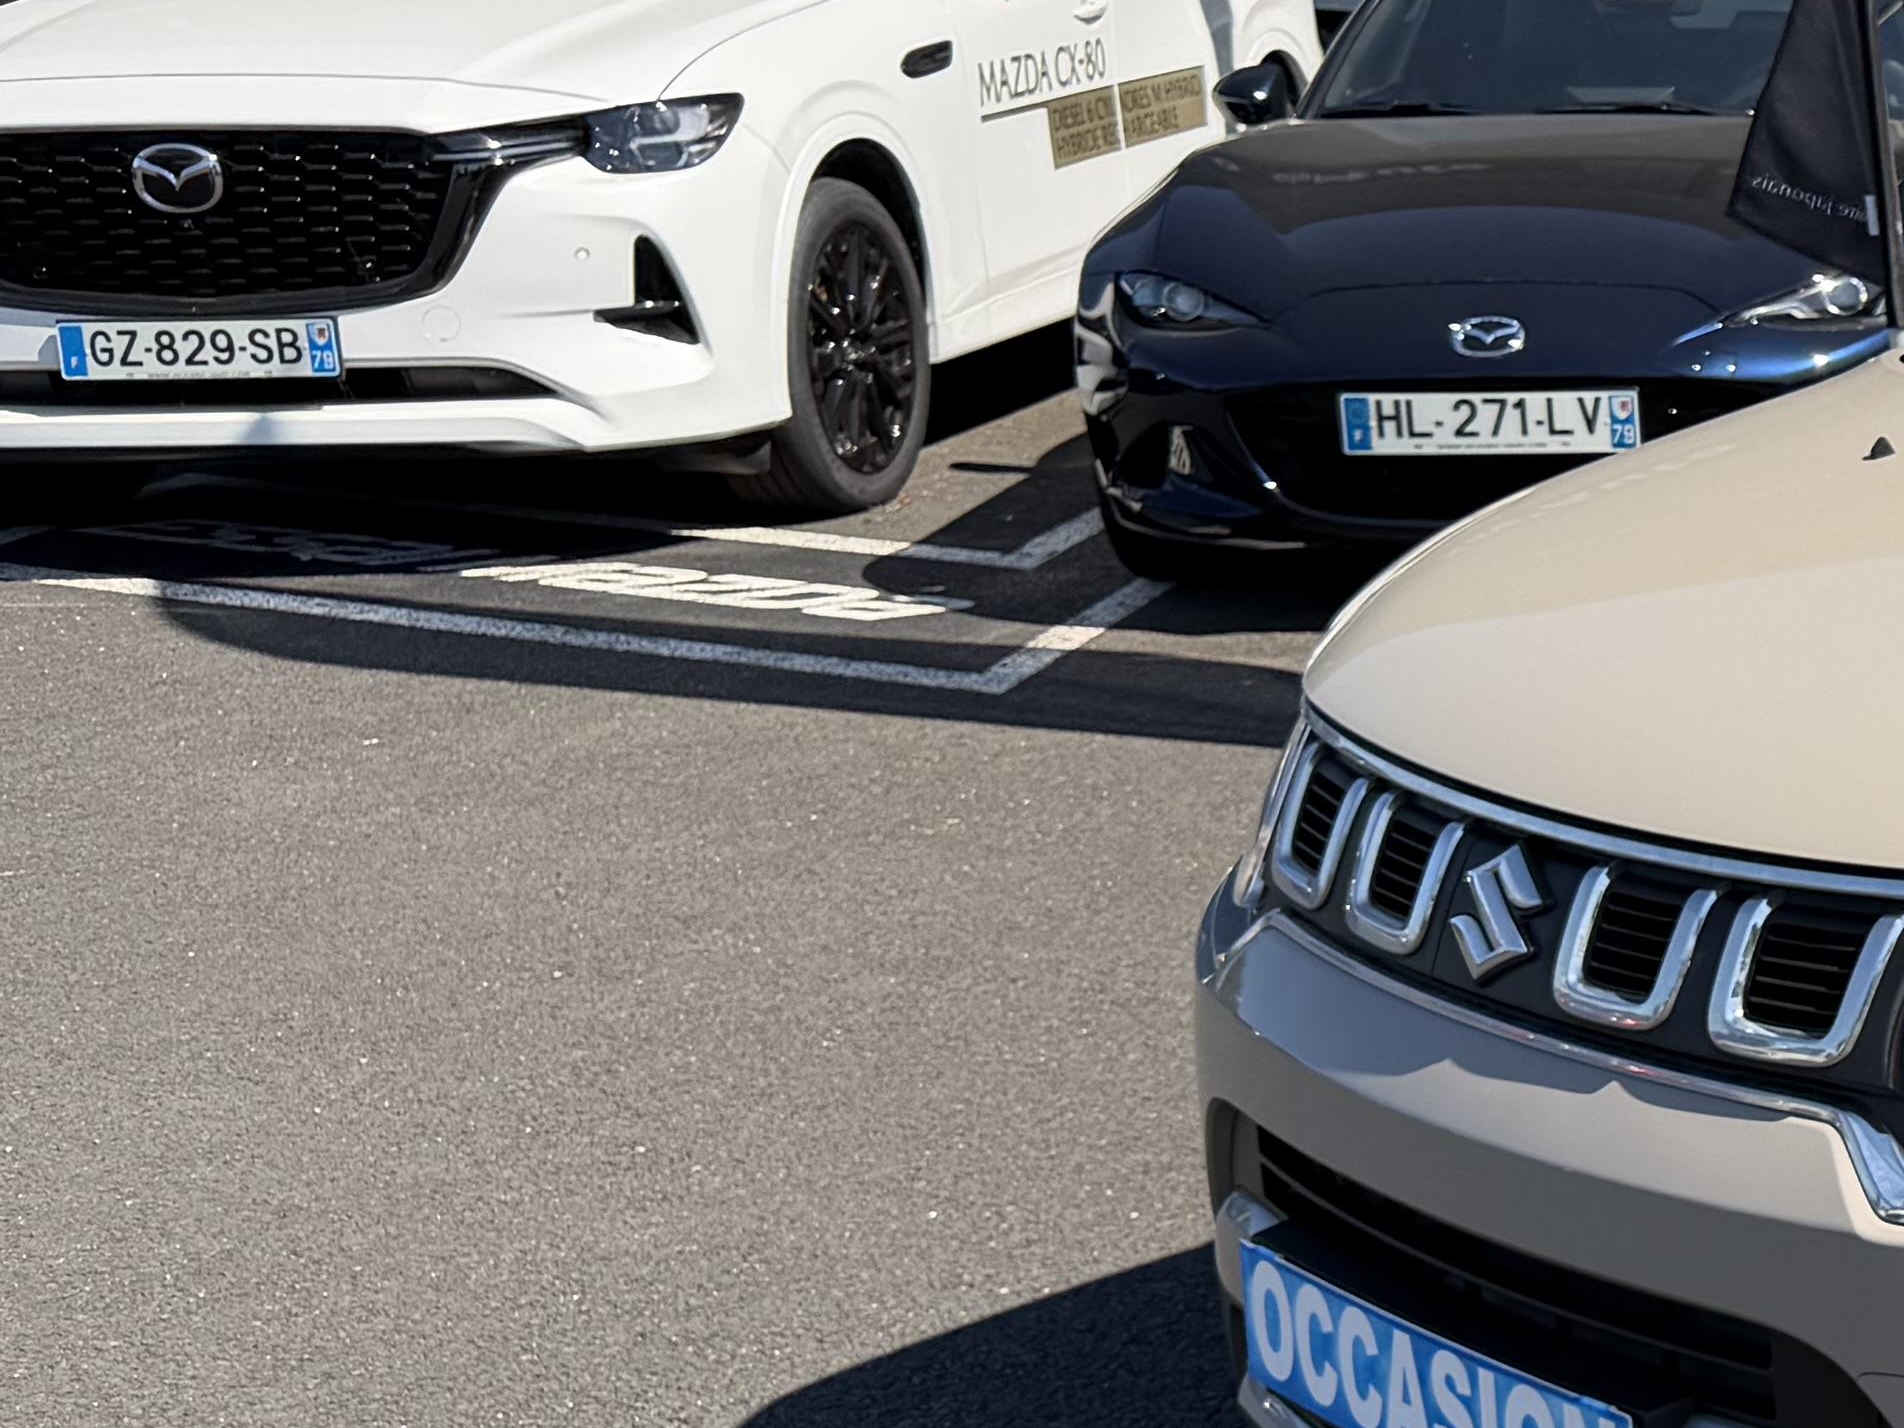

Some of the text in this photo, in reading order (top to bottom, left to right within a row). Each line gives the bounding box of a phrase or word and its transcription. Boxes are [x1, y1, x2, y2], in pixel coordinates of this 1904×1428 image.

[977, 37, 1107, 108] MAZDA CX-80
[89, 327, 304, 367] GZ-829-SB
[1374, 396, 1604, 439] HL-271-LV
